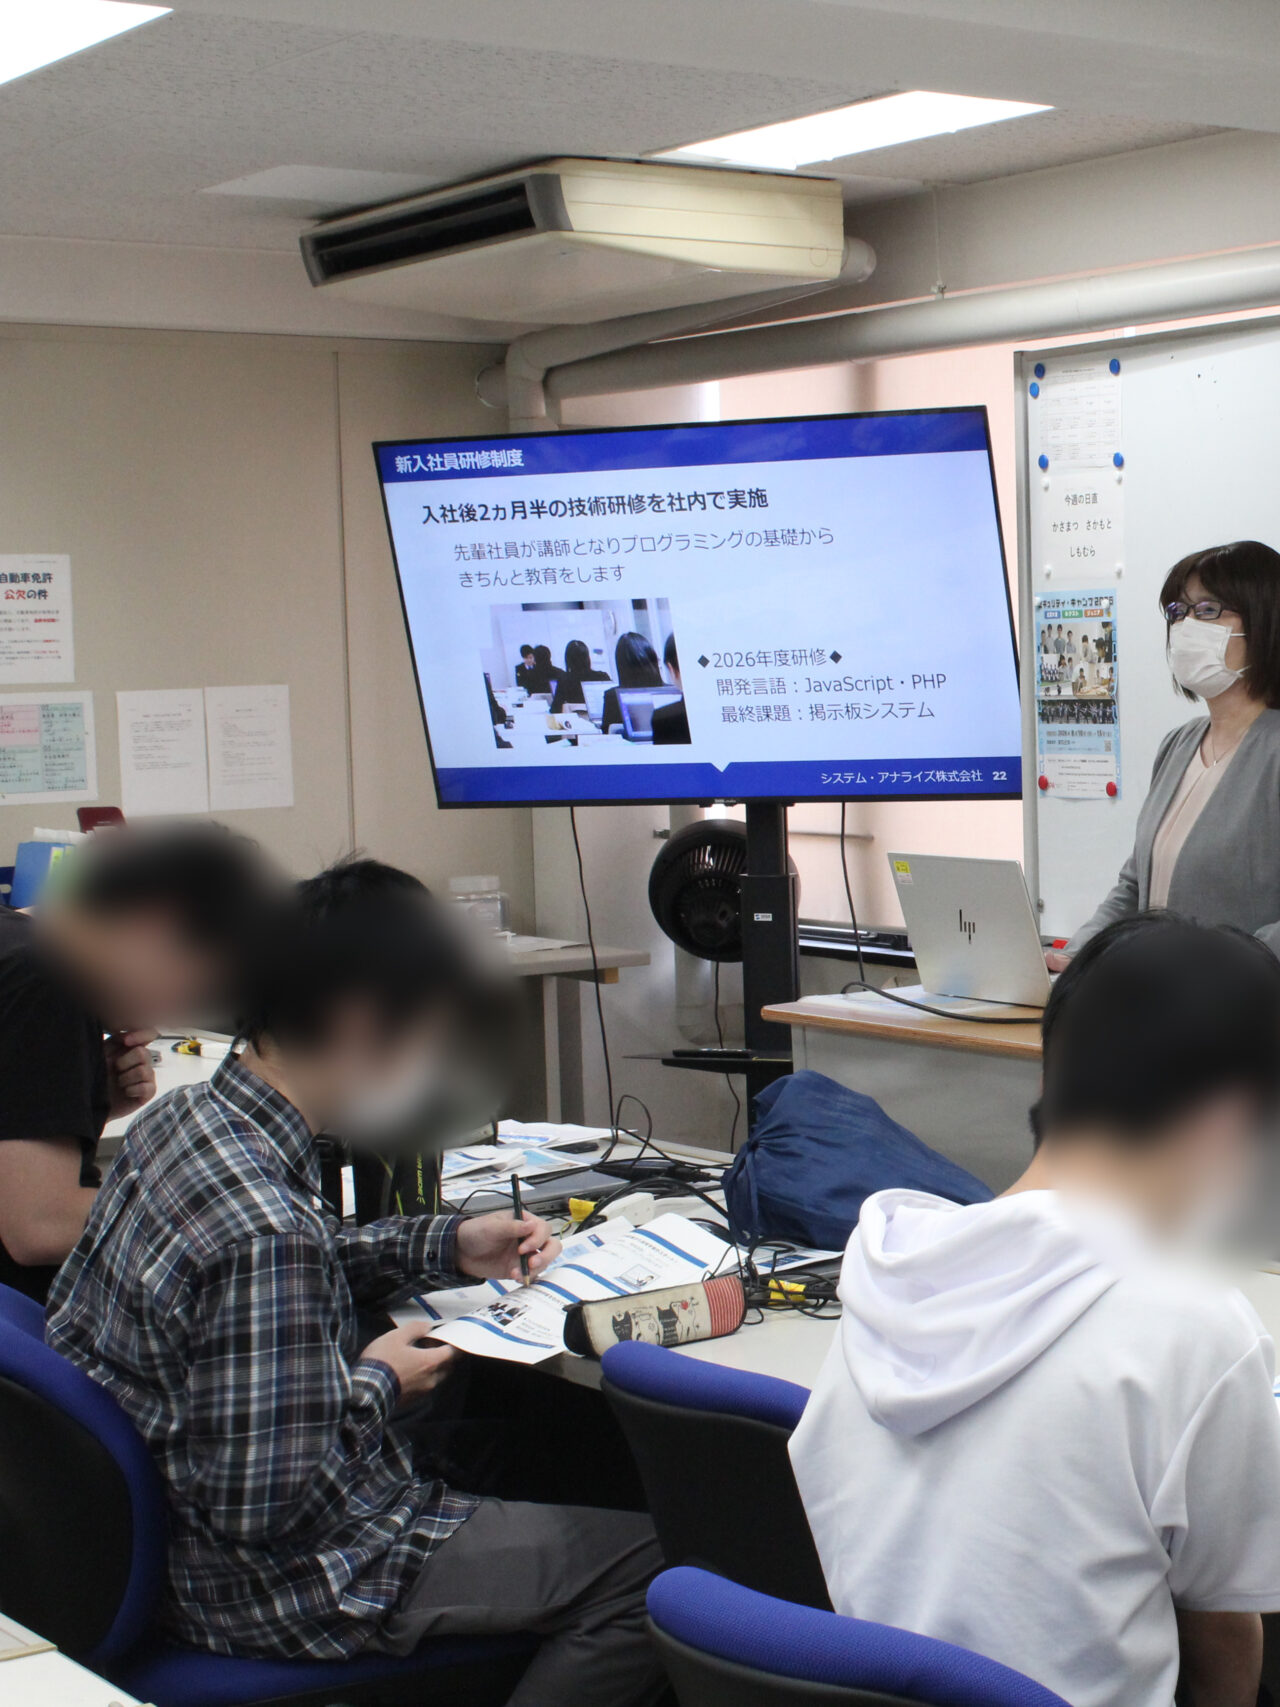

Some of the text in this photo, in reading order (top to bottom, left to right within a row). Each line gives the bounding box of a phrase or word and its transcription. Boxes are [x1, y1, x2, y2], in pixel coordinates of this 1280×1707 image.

[395, 449, 524, 474] 新入社員研修制度
[1064, 493, 1098, 506] 今週の日直
[1086, 518, 1112, 531] さかもと
[454, 526, 835, 561] 先輩社員が講師となりプログラミングの基礎から
[1070, 545, 1096, 558] しもむら
[458, 564, 626, 588] きちんと教育をします
[4, 589, 49, 600] 公欠の件
[820, 770, 1008, 785] システム・アナライズ株式会社 22
